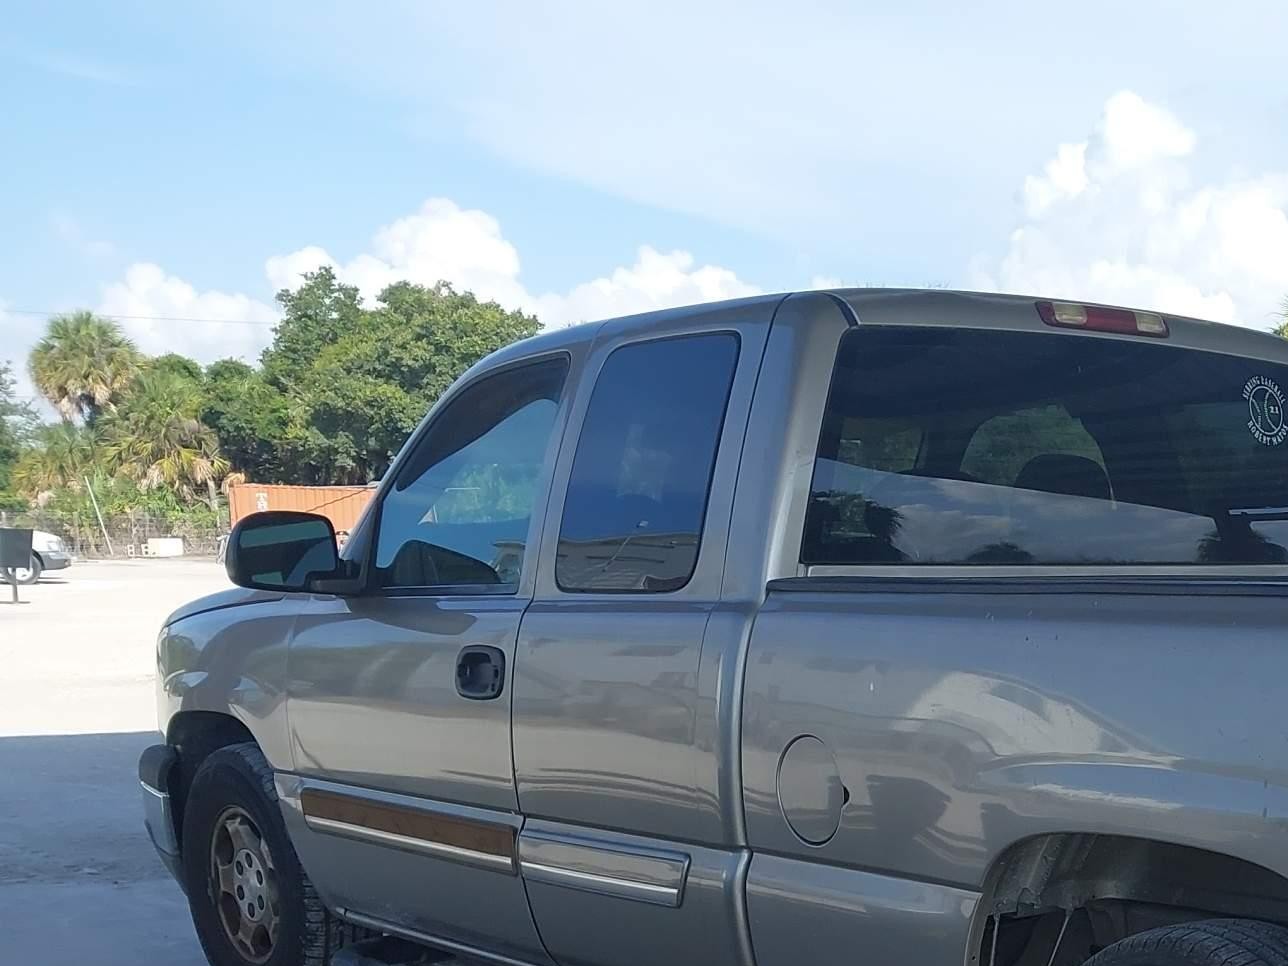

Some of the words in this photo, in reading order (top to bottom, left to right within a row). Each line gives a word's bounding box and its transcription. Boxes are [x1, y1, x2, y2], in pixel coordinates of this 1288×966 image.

[1261, 375, 1287, 404] BASEBALL
[1268, 406, 1279, 414] 21
[1247, 420, 1271, 446] ROBERT
